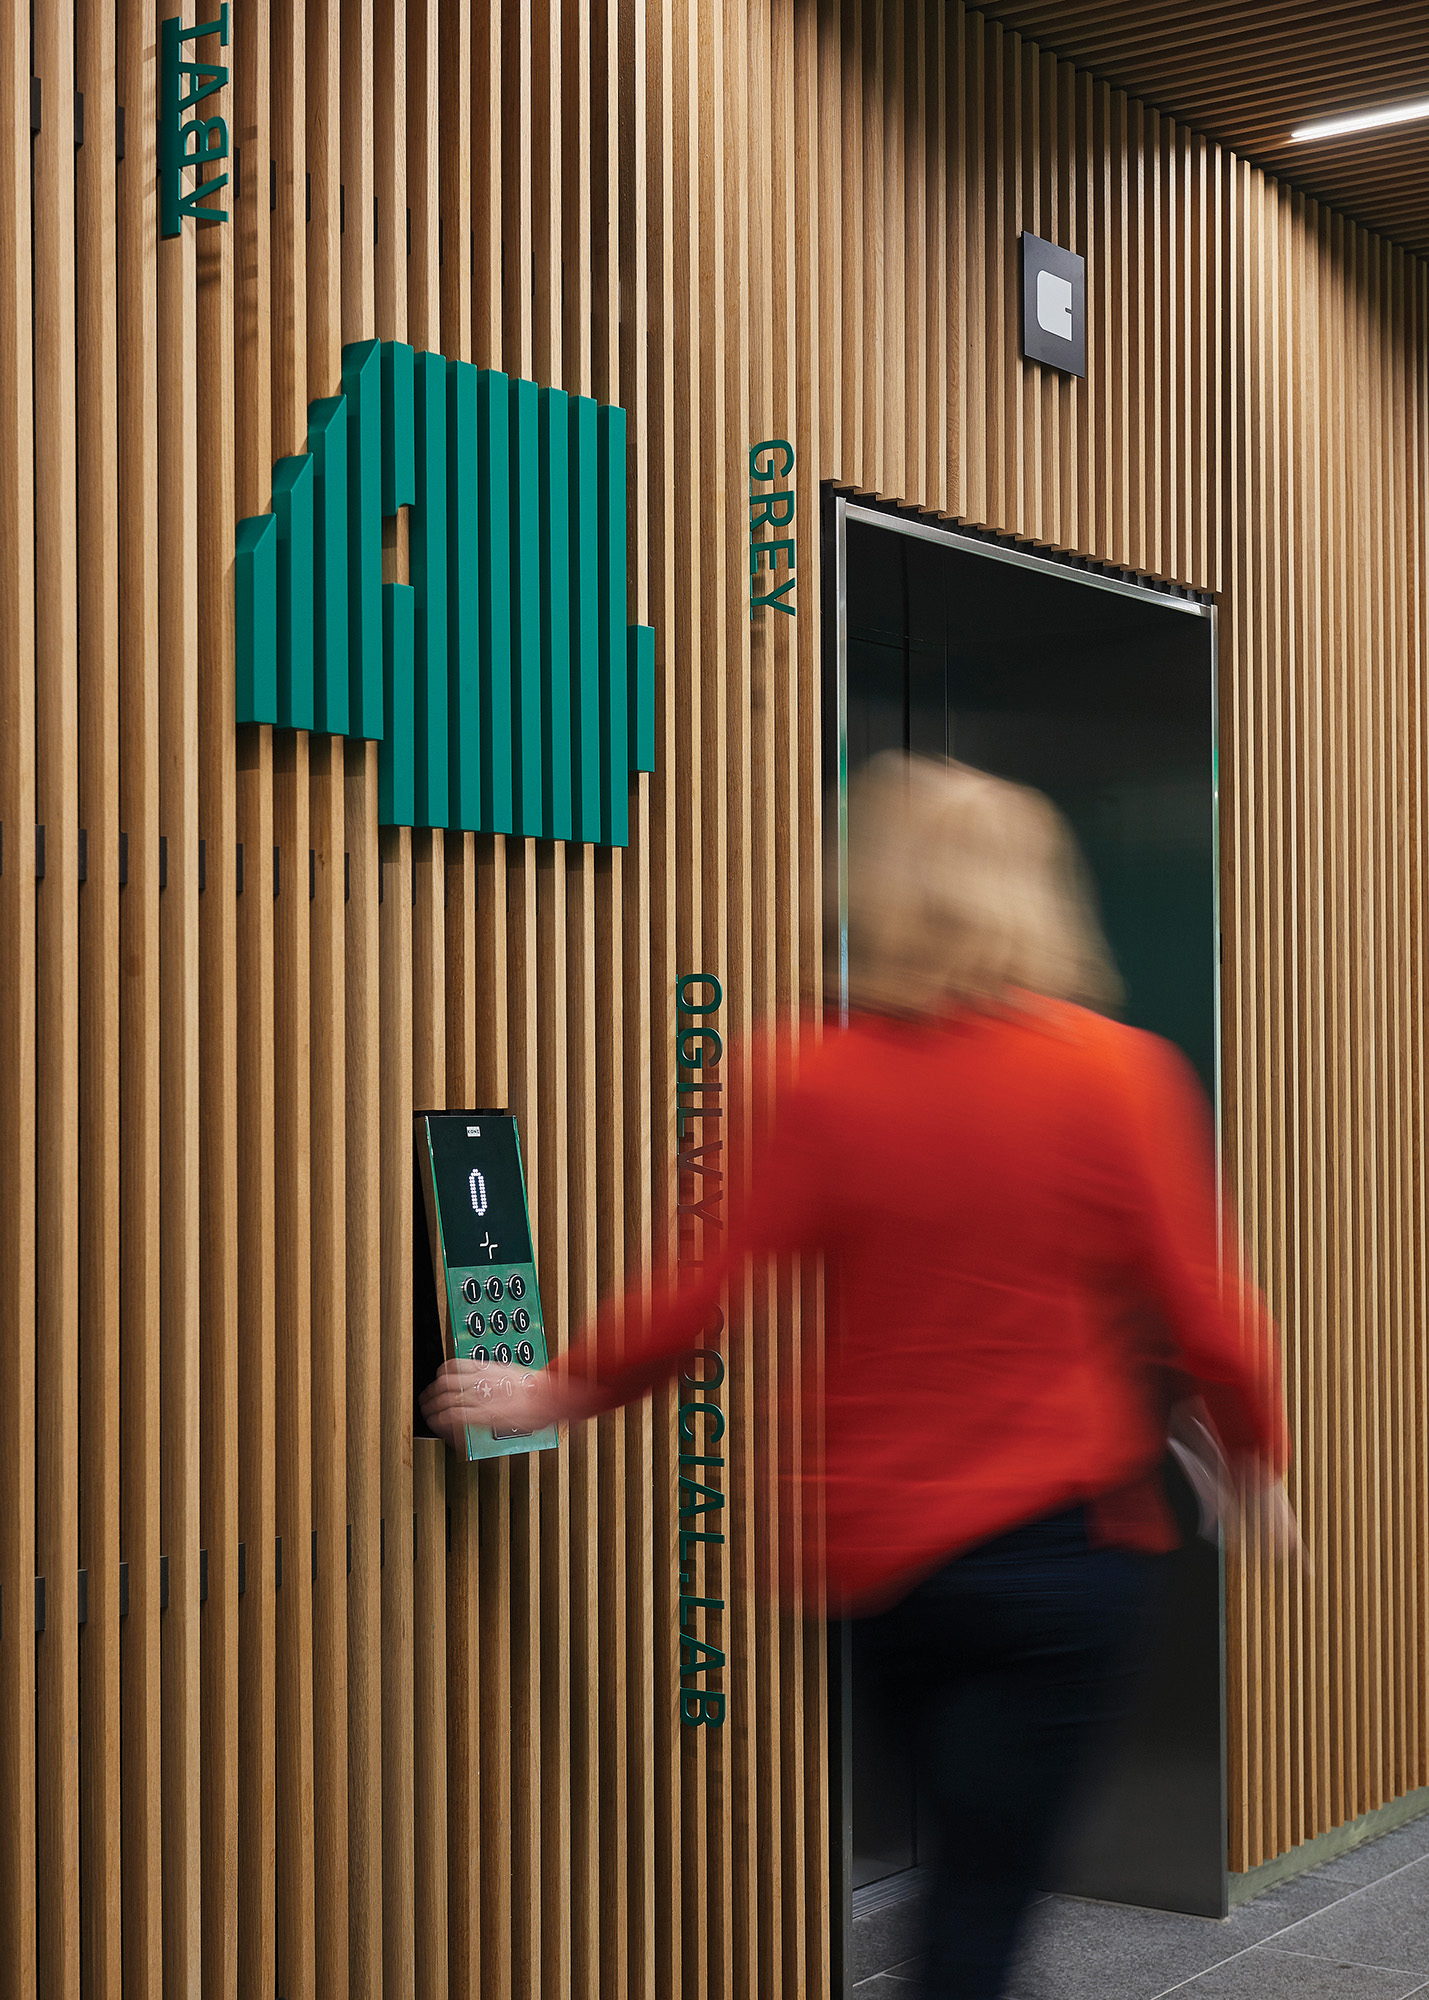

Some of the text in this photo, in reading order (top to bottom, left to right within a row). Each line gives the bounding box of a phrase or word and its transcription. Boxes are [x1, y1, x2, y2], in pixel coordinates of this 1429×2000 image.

[750, 439, 796, 617] GREY
[677, 973, 724, 1231] OGILVY
[468, 1168, 488, 1217] 0
[470, 1279, 522, 1299] 1 2 3
[475, 1312, 526, 1332] 4 5 6
[479, 1344, 530, 1365] 7 8 9
